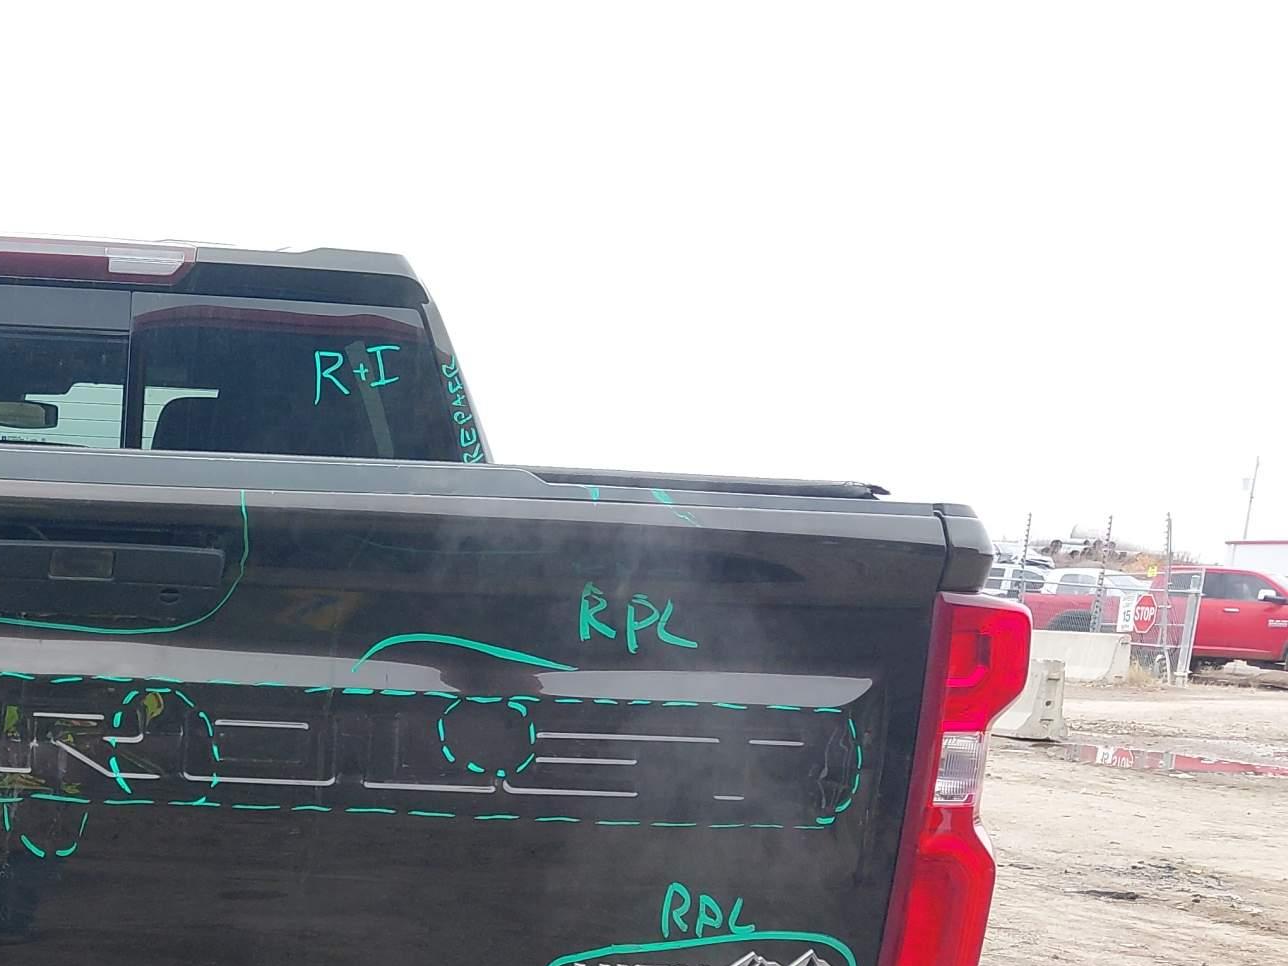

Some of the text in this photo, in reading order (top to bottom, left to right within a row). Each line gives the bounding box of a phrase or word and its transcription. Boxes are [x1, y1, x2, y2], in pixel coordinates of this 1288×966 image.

[314, 345, 401, 405] R+I
[579, 581, 699, 654] RPL
[1134, 605, 1155, 622] STOP
[660, 882, 756, 938] RPL
